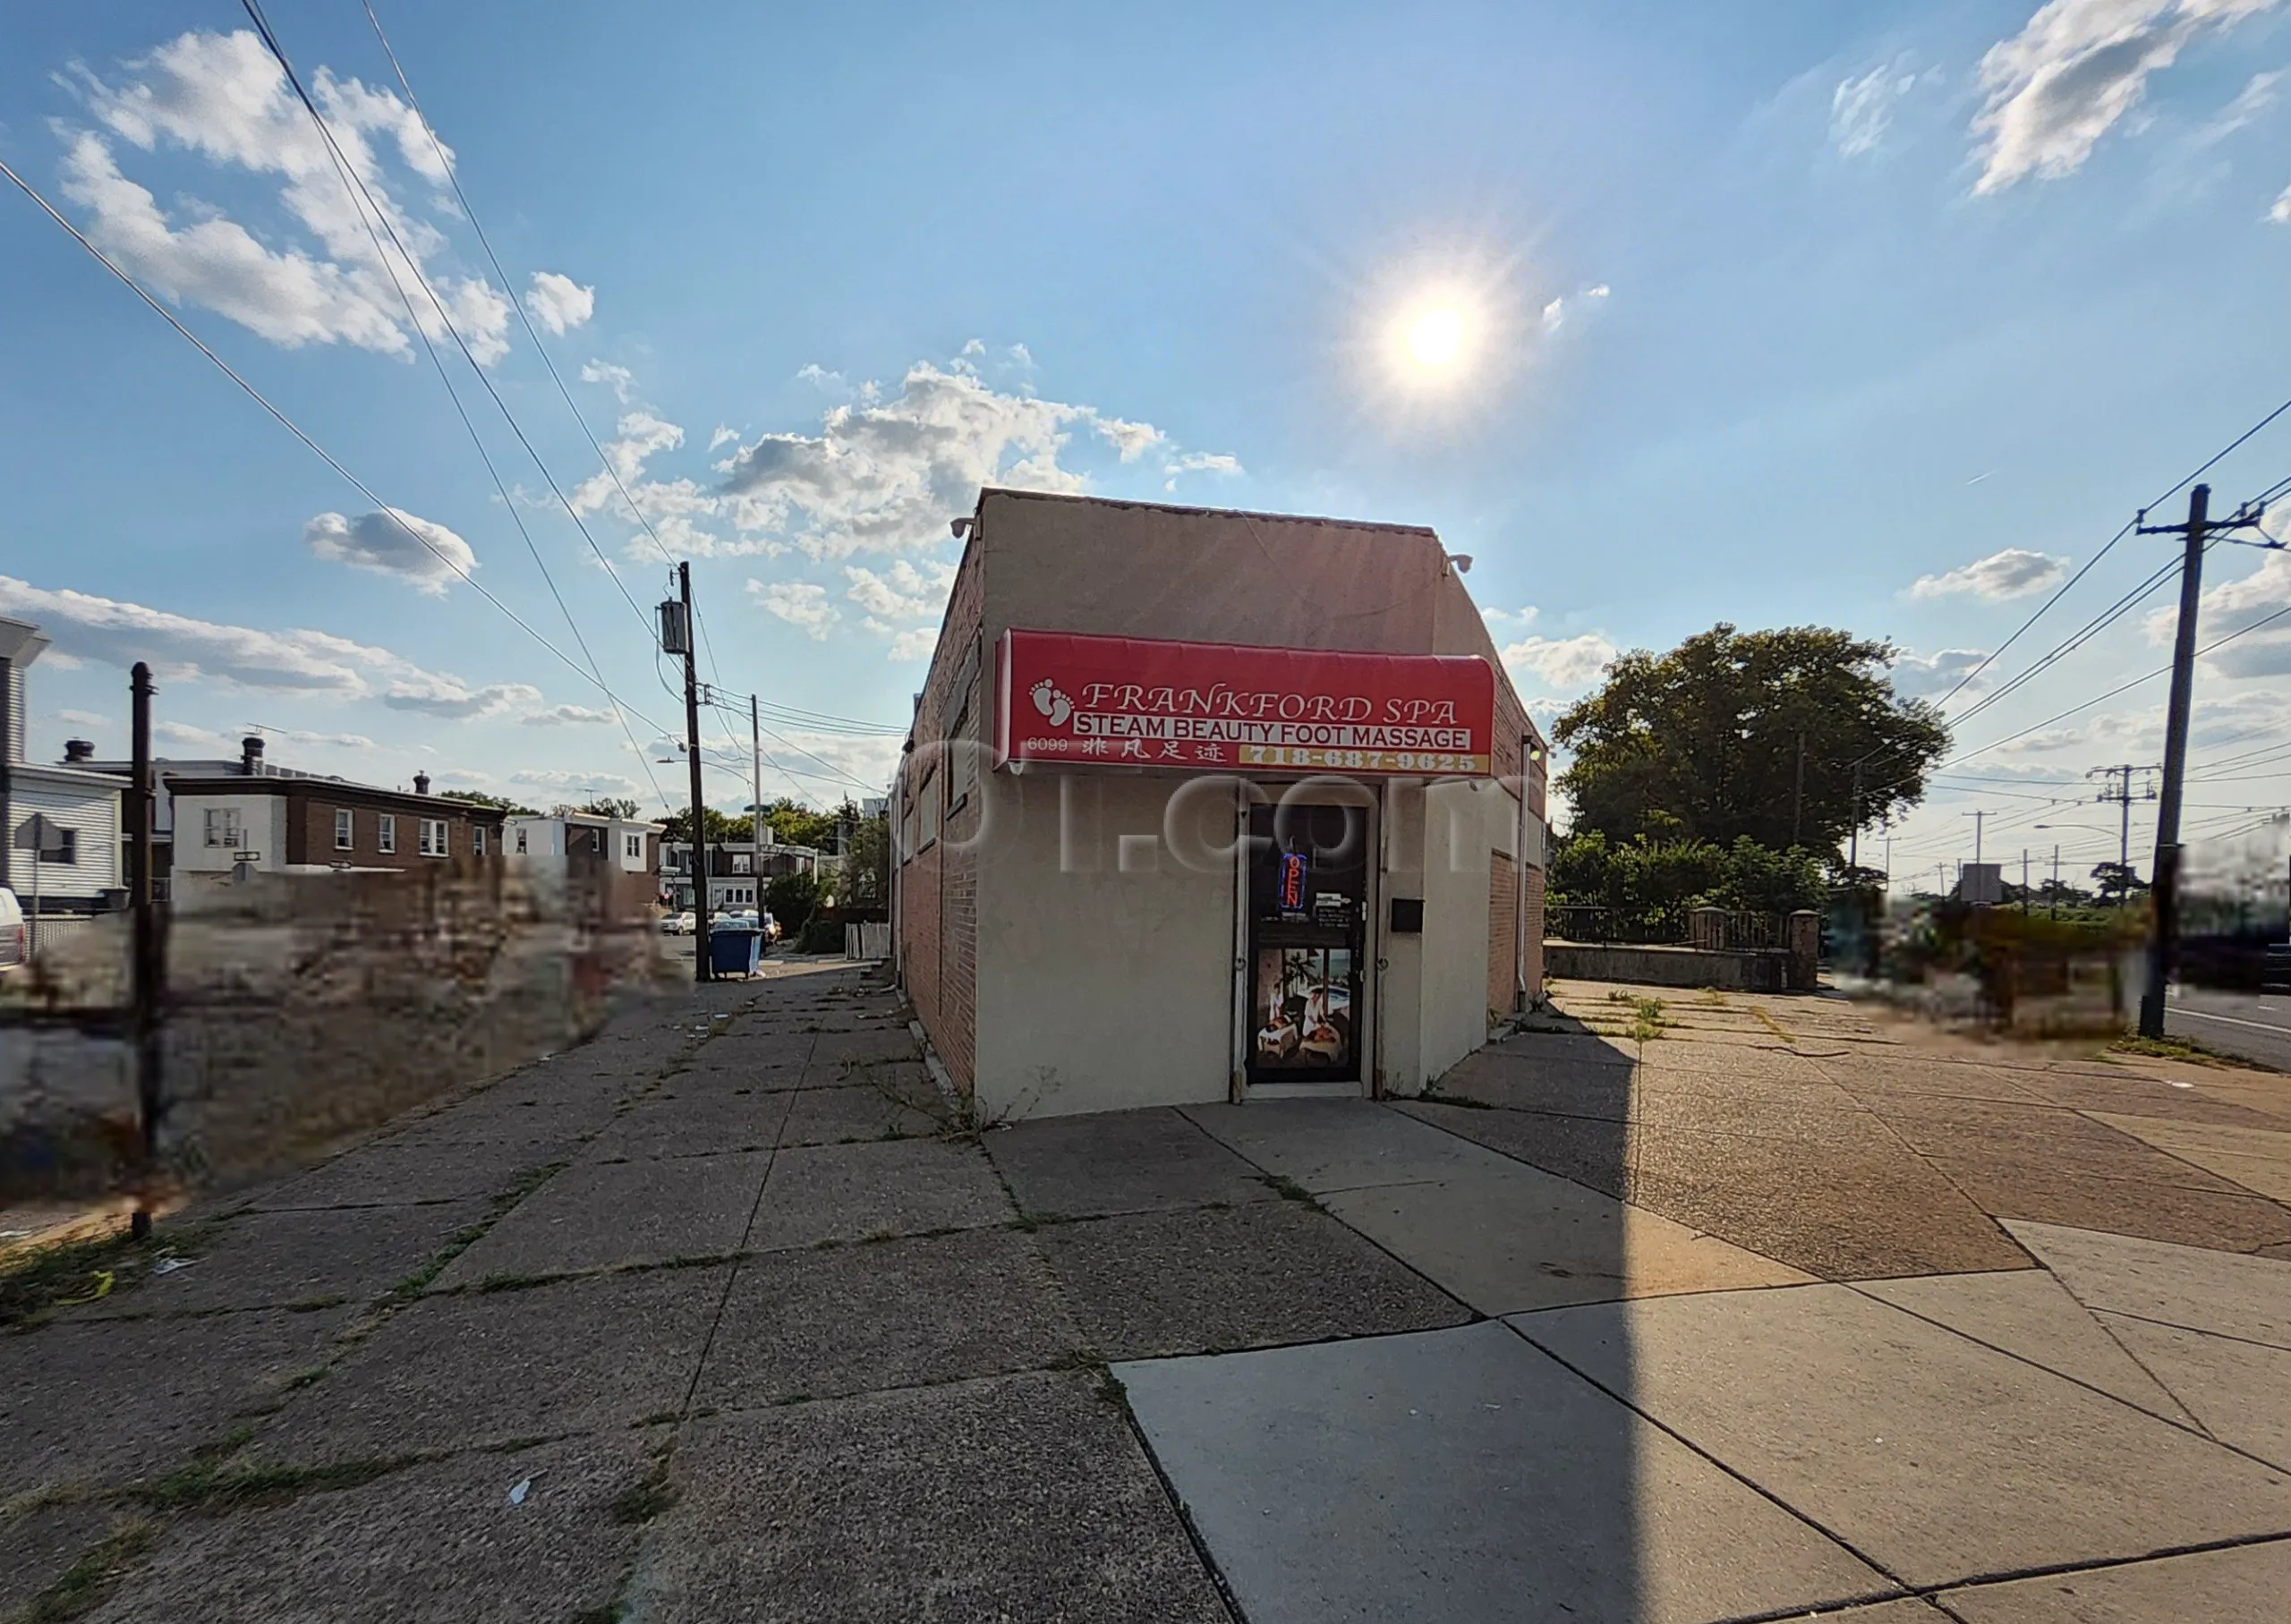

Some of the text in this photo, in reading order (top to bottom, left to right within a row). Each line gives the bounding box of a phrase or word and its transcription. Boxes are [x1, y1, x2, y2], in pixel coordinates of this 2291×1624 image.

[1082, 683, 1458, 724] FRANKFORD SPA
[1027, 737, 1069, 752] 6099
[1077, 714, 1467, 749] STEAM BEAUTY FOOT MASSAGE
[1249, 744, 1476, 771] 718-687-9625
[1287, 855, 1300, 907] OPEN
